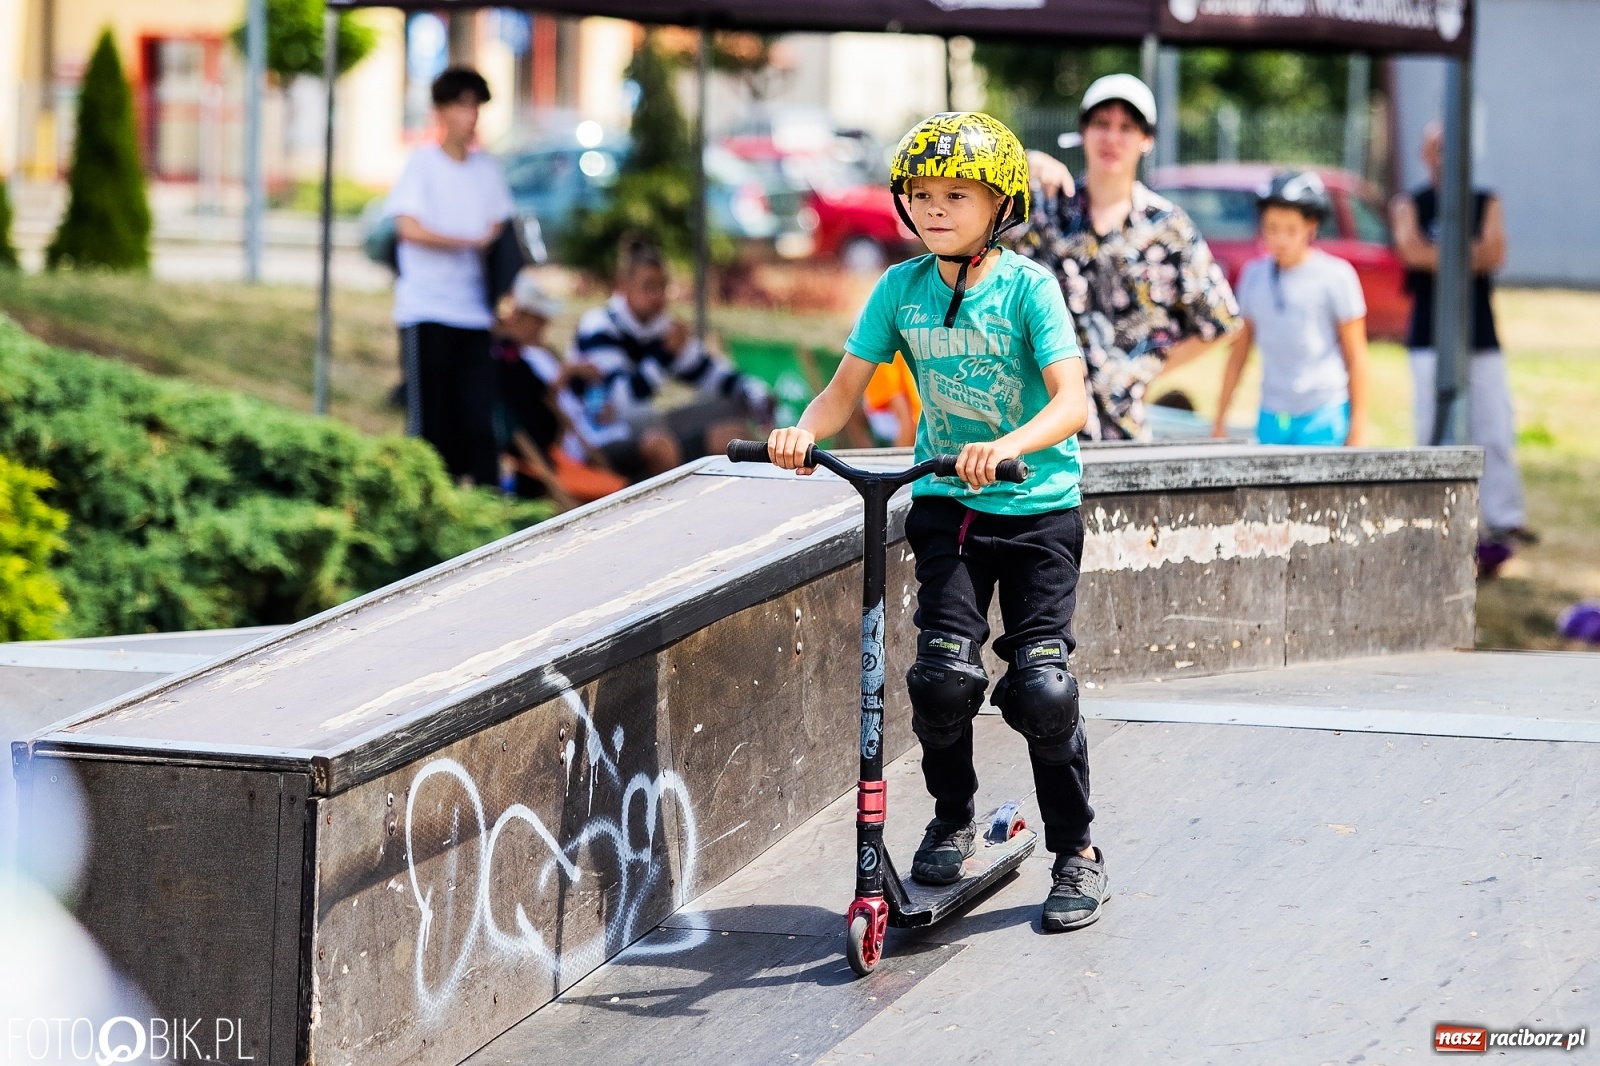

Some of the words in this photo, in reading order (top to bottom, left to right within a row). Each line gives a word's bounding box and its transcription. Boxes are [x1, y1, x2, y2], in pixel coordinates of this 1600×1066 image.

[900, 304, 928, 325] The
[900, 326, 1011, 360] HIGHWAY
[953, 357, 1008, 381] Stop
[933, 373, 990, 402] Gasoline
[937, 383, 994, 412] Station
